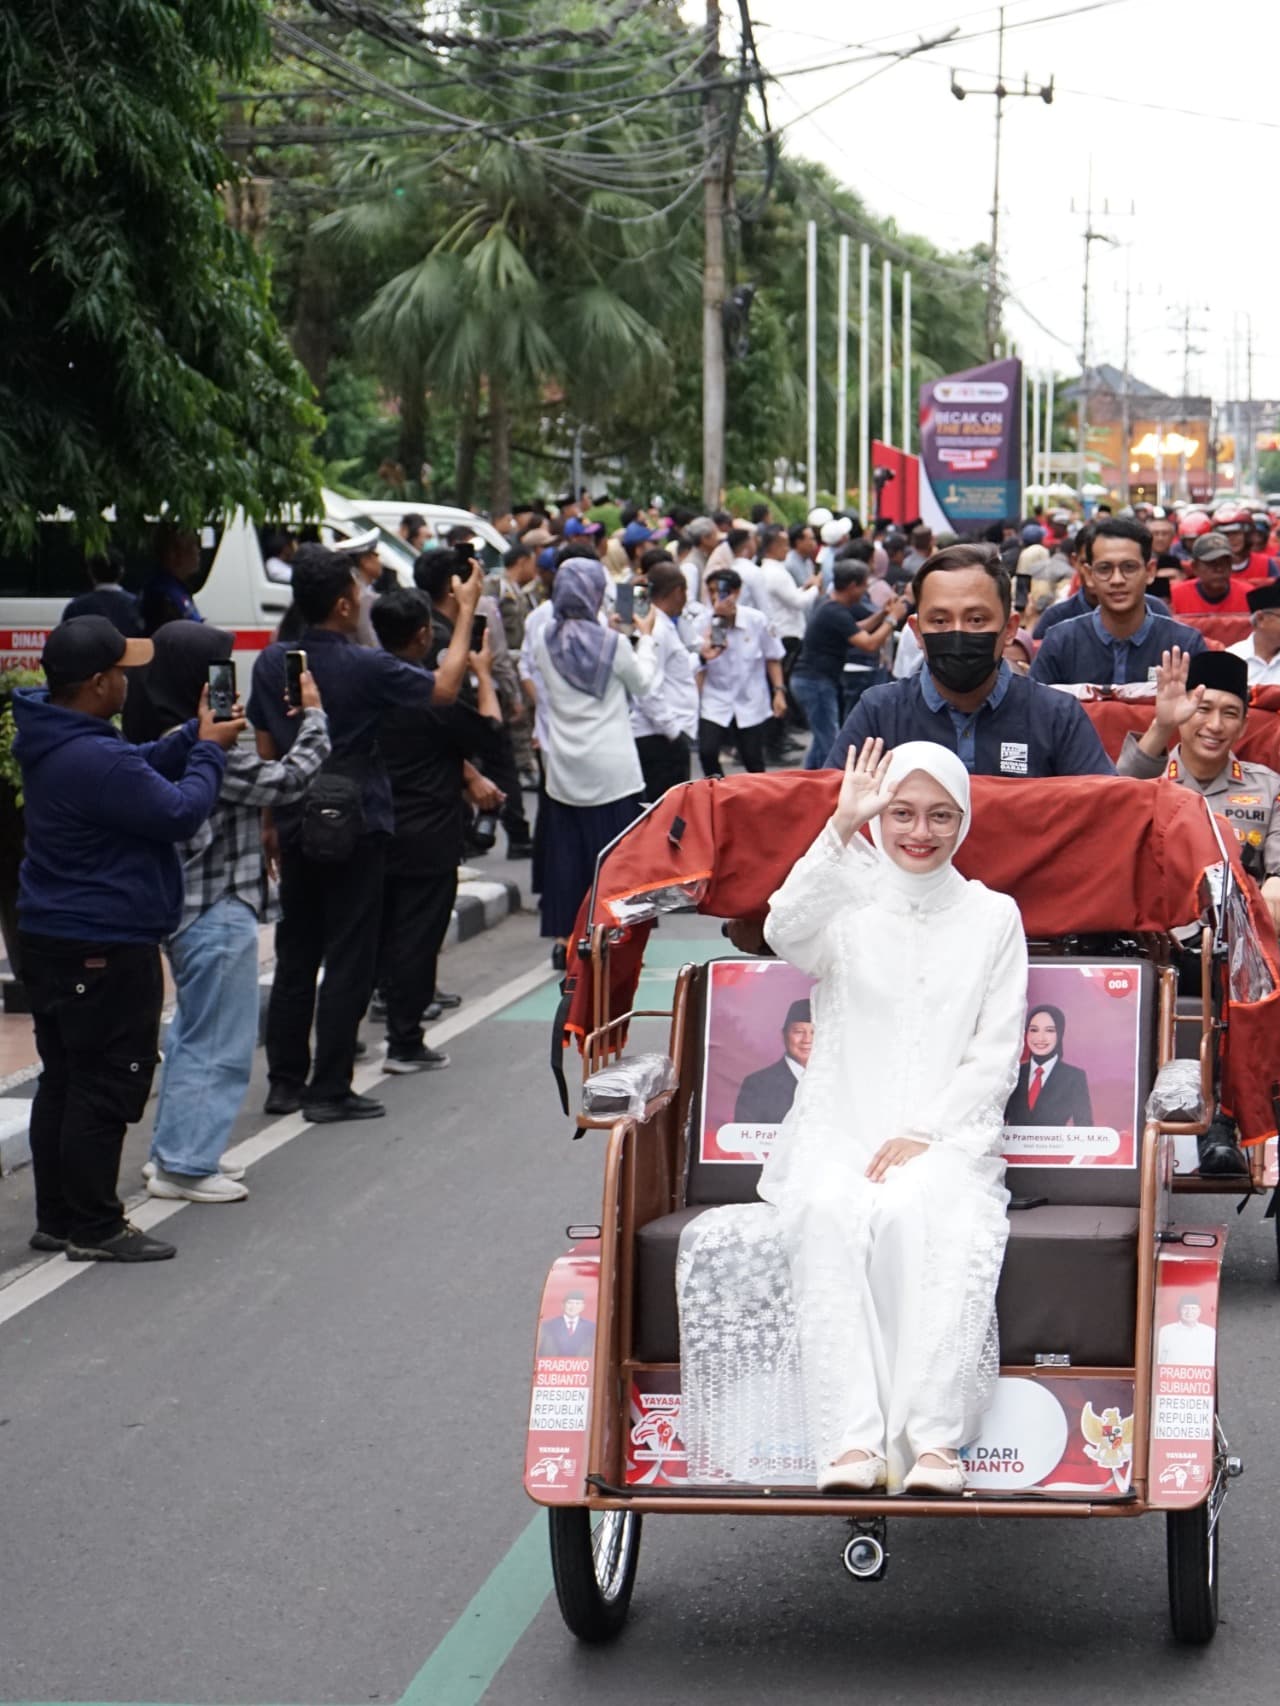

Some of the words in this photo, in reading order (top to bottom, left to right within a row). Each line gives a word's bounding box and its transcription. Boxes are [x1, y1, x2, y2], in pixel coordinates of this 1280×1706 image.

[981, 412, 1003, 424] ON
[1225, 809, 1265, 822] POLRI
[538, 1360, 589, 1372] PRABOWO
[1160, 1366, 1212, 1379] PRABOWO
[537, 1374, 587, 1386] SUBIANTO
[1160, 1381, 1210, 1394] SUBIANTO
[536, 1390, 585, 1401] PRESIDEN
[644, 1397, 680, 1406] YAYASA
[534, 1404, 584, 1415] REPUBLIK
[1158, 1398, 1210, 1410] PRESIDEN
[530, 1418, 584, 1430] INDONESIA
[1158, 1412, 1209, 1424] REPUBLIK
[1156, 1426, 1211, 1438] INDONESIA
[976, 1448, 1018, 1460] DARI
[962, 1460, 1024, 1473] BIANTO
